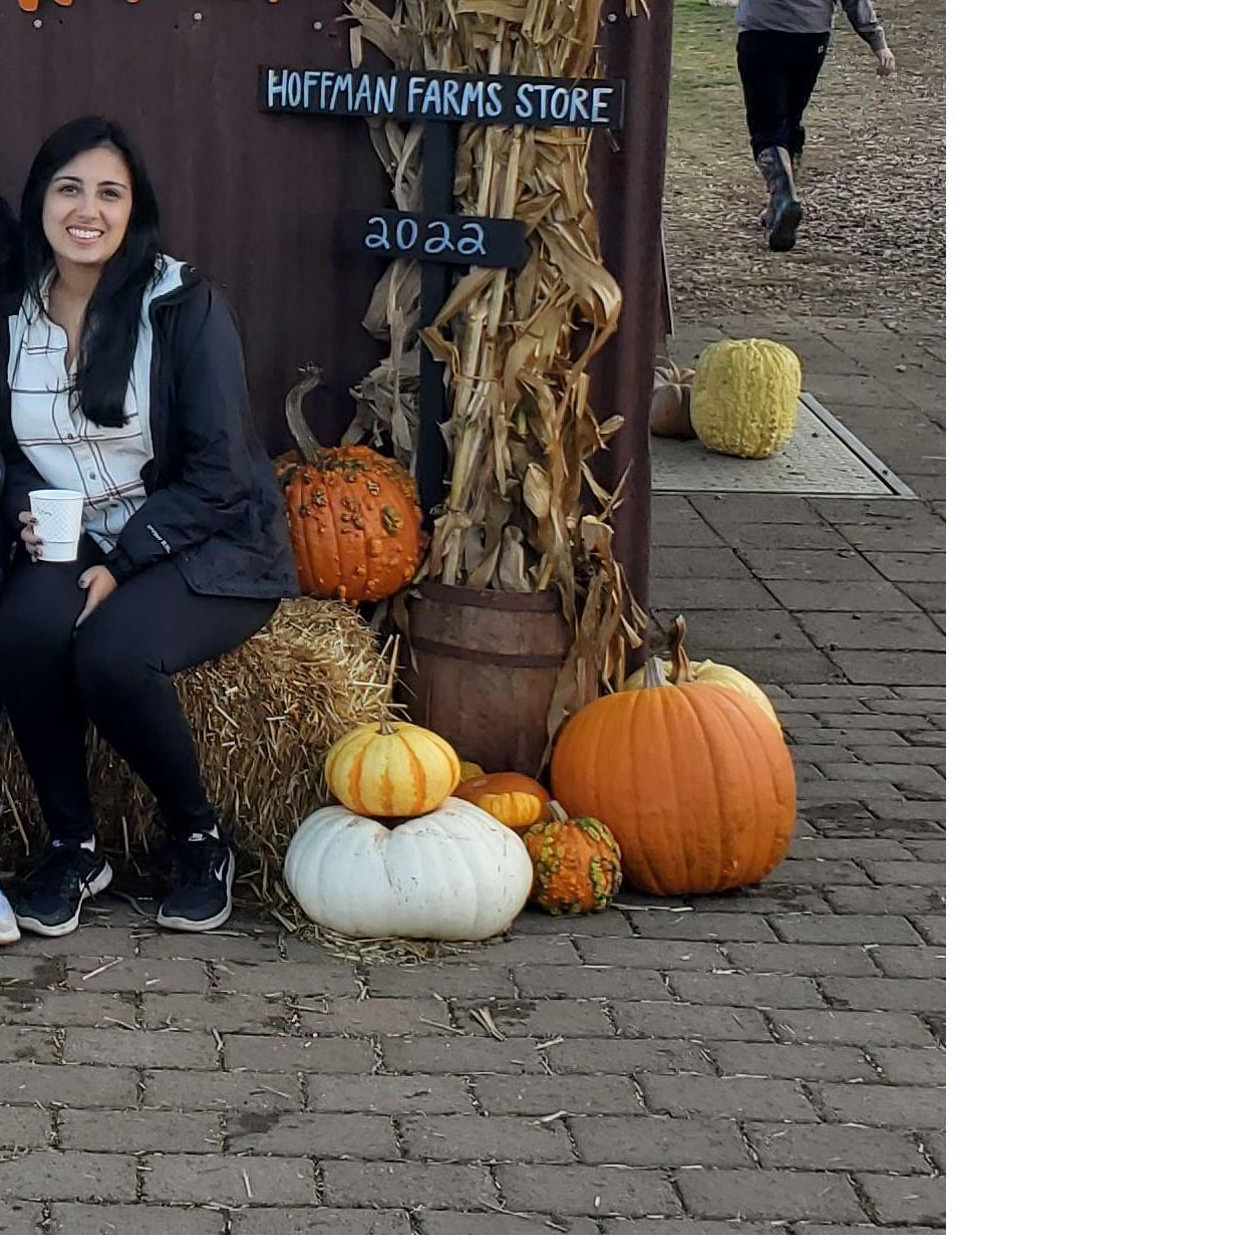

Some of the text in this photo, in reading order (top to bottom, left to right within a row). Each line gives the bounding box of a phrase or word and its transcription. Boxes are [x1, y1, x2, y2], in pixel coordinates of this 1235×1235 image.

[267, 69, 614, 123] HOFFMAN FARMS STORE
[364, 216, 487, 256] 2022
